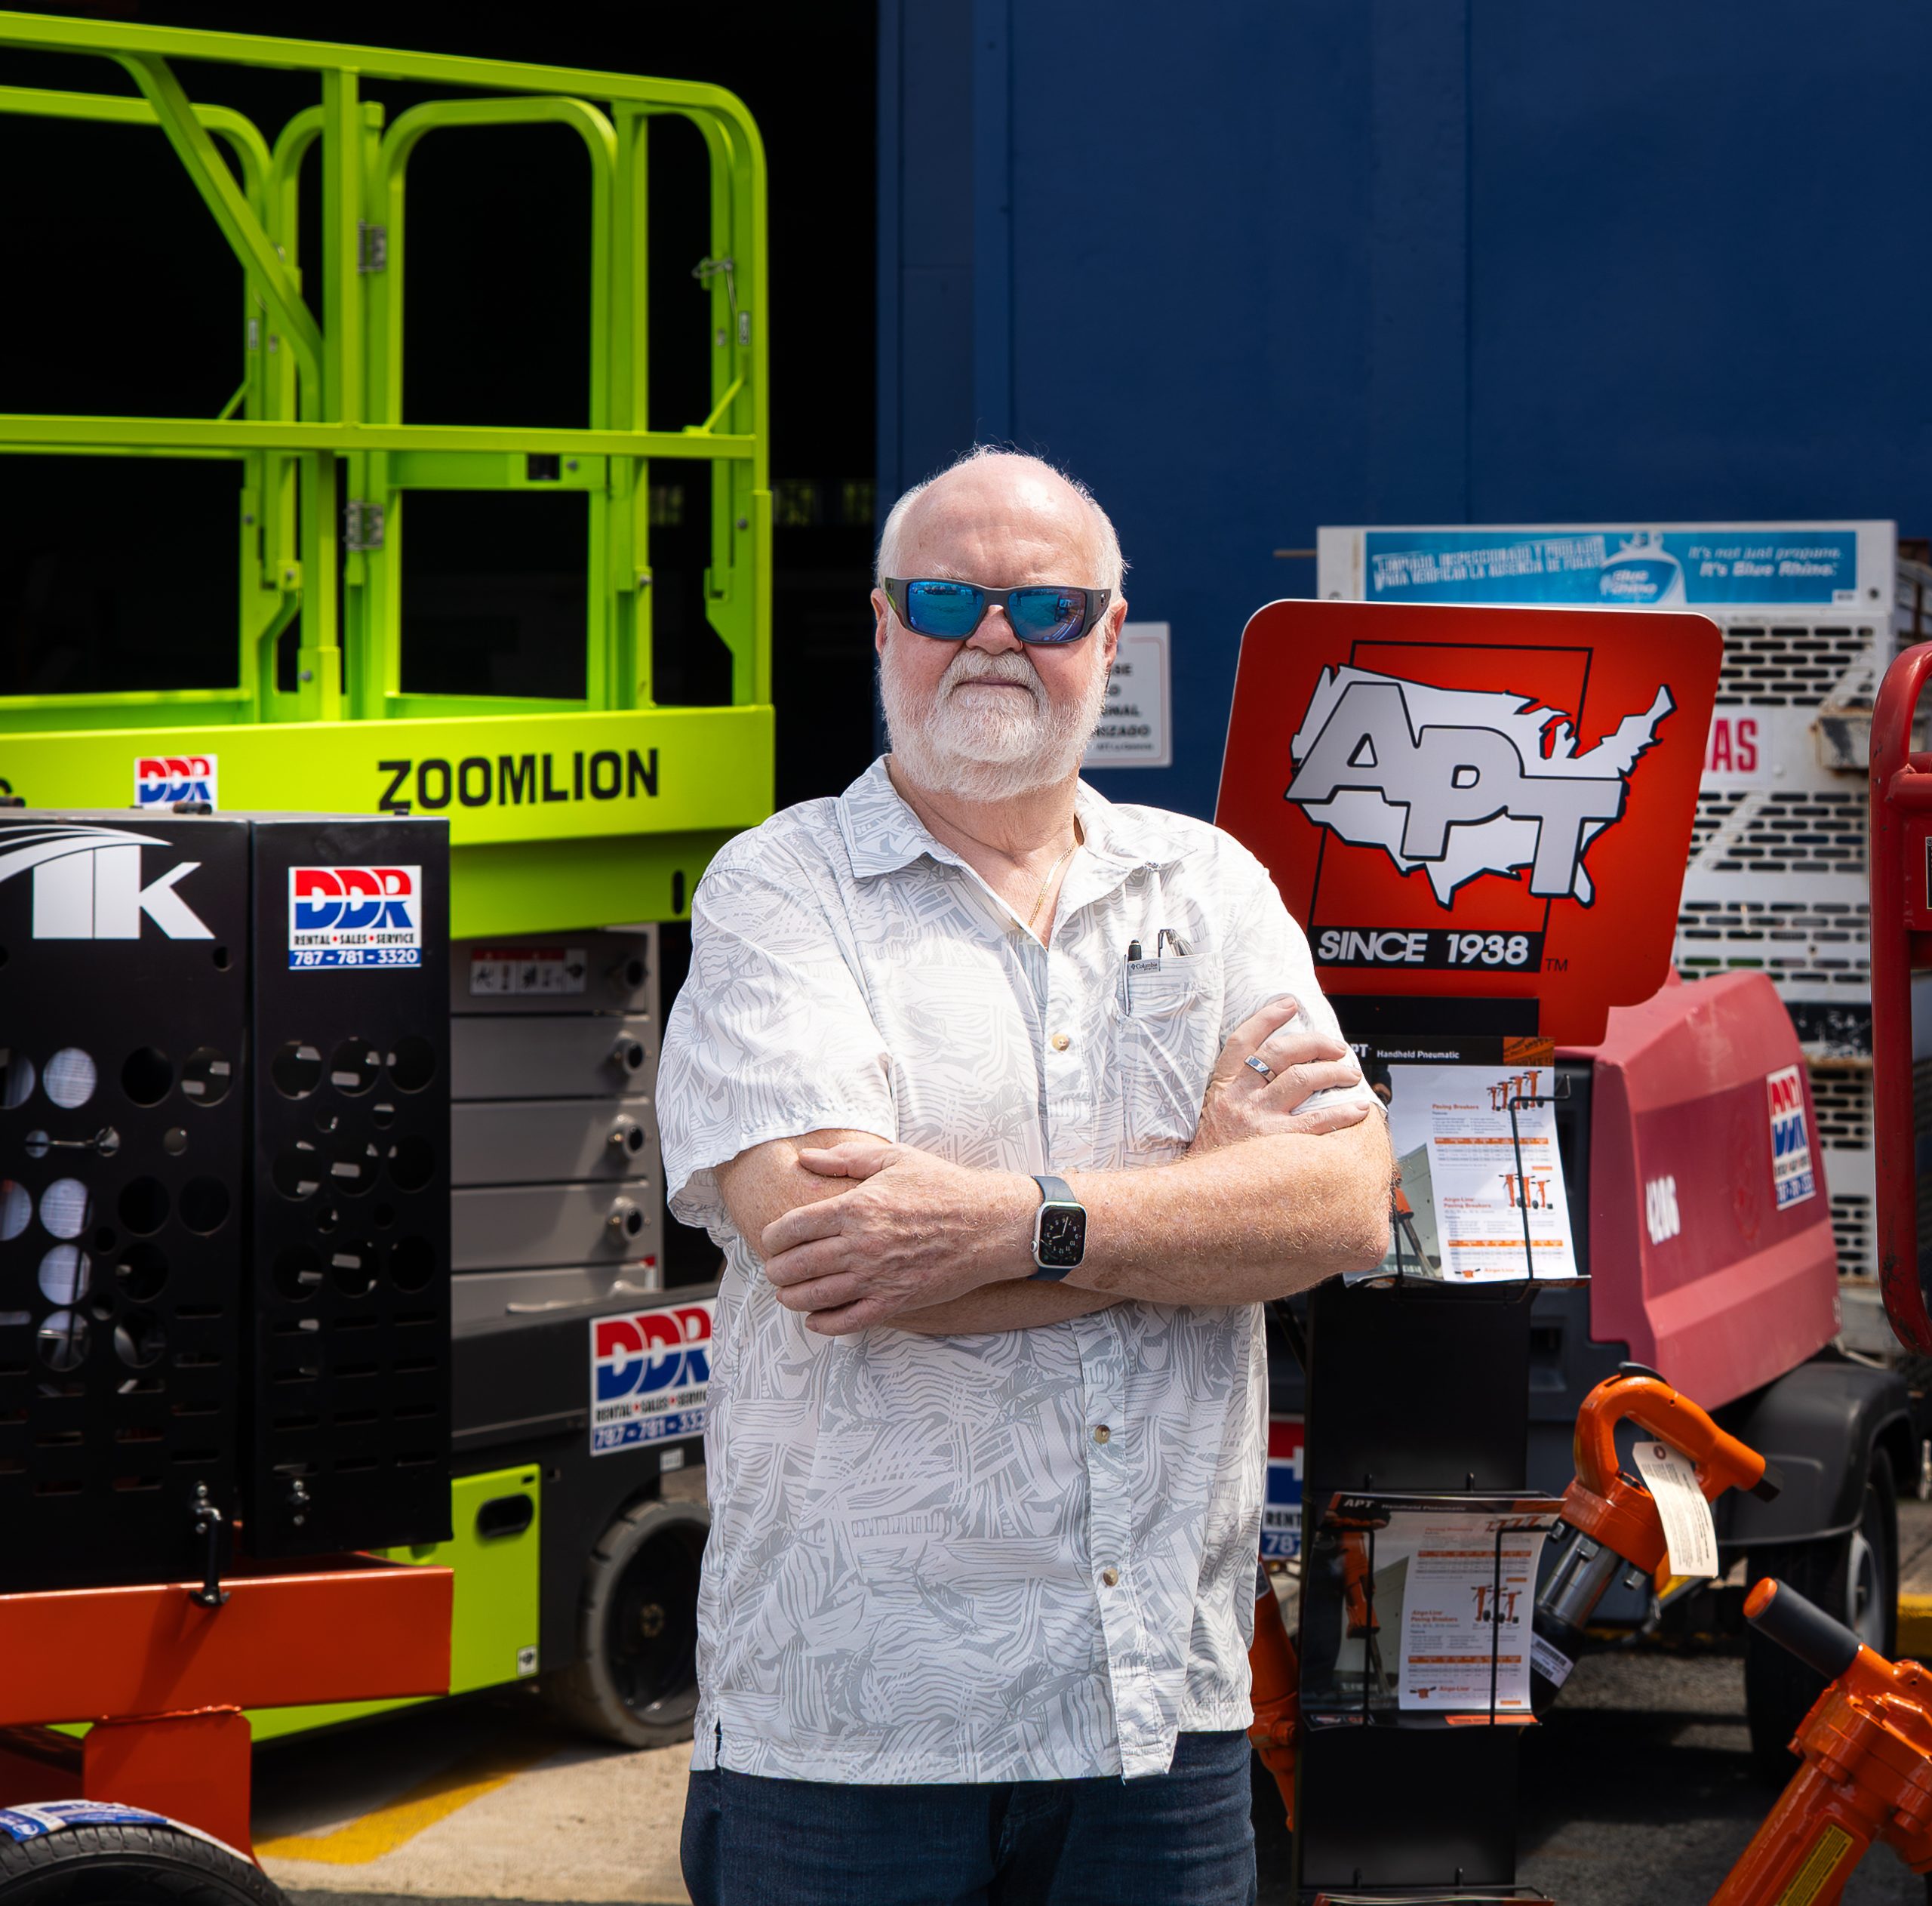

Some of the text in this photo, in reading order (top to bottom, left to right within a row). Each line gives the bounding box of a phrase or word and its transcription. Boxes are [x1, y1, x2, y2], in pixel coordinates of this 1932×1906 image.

[1709, 718, 1758, 772] AS
[140, 756, 211, 804] DDR
[377, 748, 659, 811] ZOOMLION
[1284, 682, 1629, 898] APT
[295, 869, 414, 930] DDR
[294, 933, 414, 945] RENTAL SALES SERVICE
[1318, 930, 1428, 964] SINCE
[1447, 934, 1529, 966] 1938
[1349, 1043, 1369, 1058] PT
[1377, 1050, 1460, 1059] Handheld Pneumatic
[598, 1309, 712, 1401] DDR
[597, 1403, 632, 1422] RENTAL
[677, 1390, 706, 1406] SERVIC
[1266, 1512, 1301, 1527] RENT
[1343, 1498, 1374, 1509] APT
